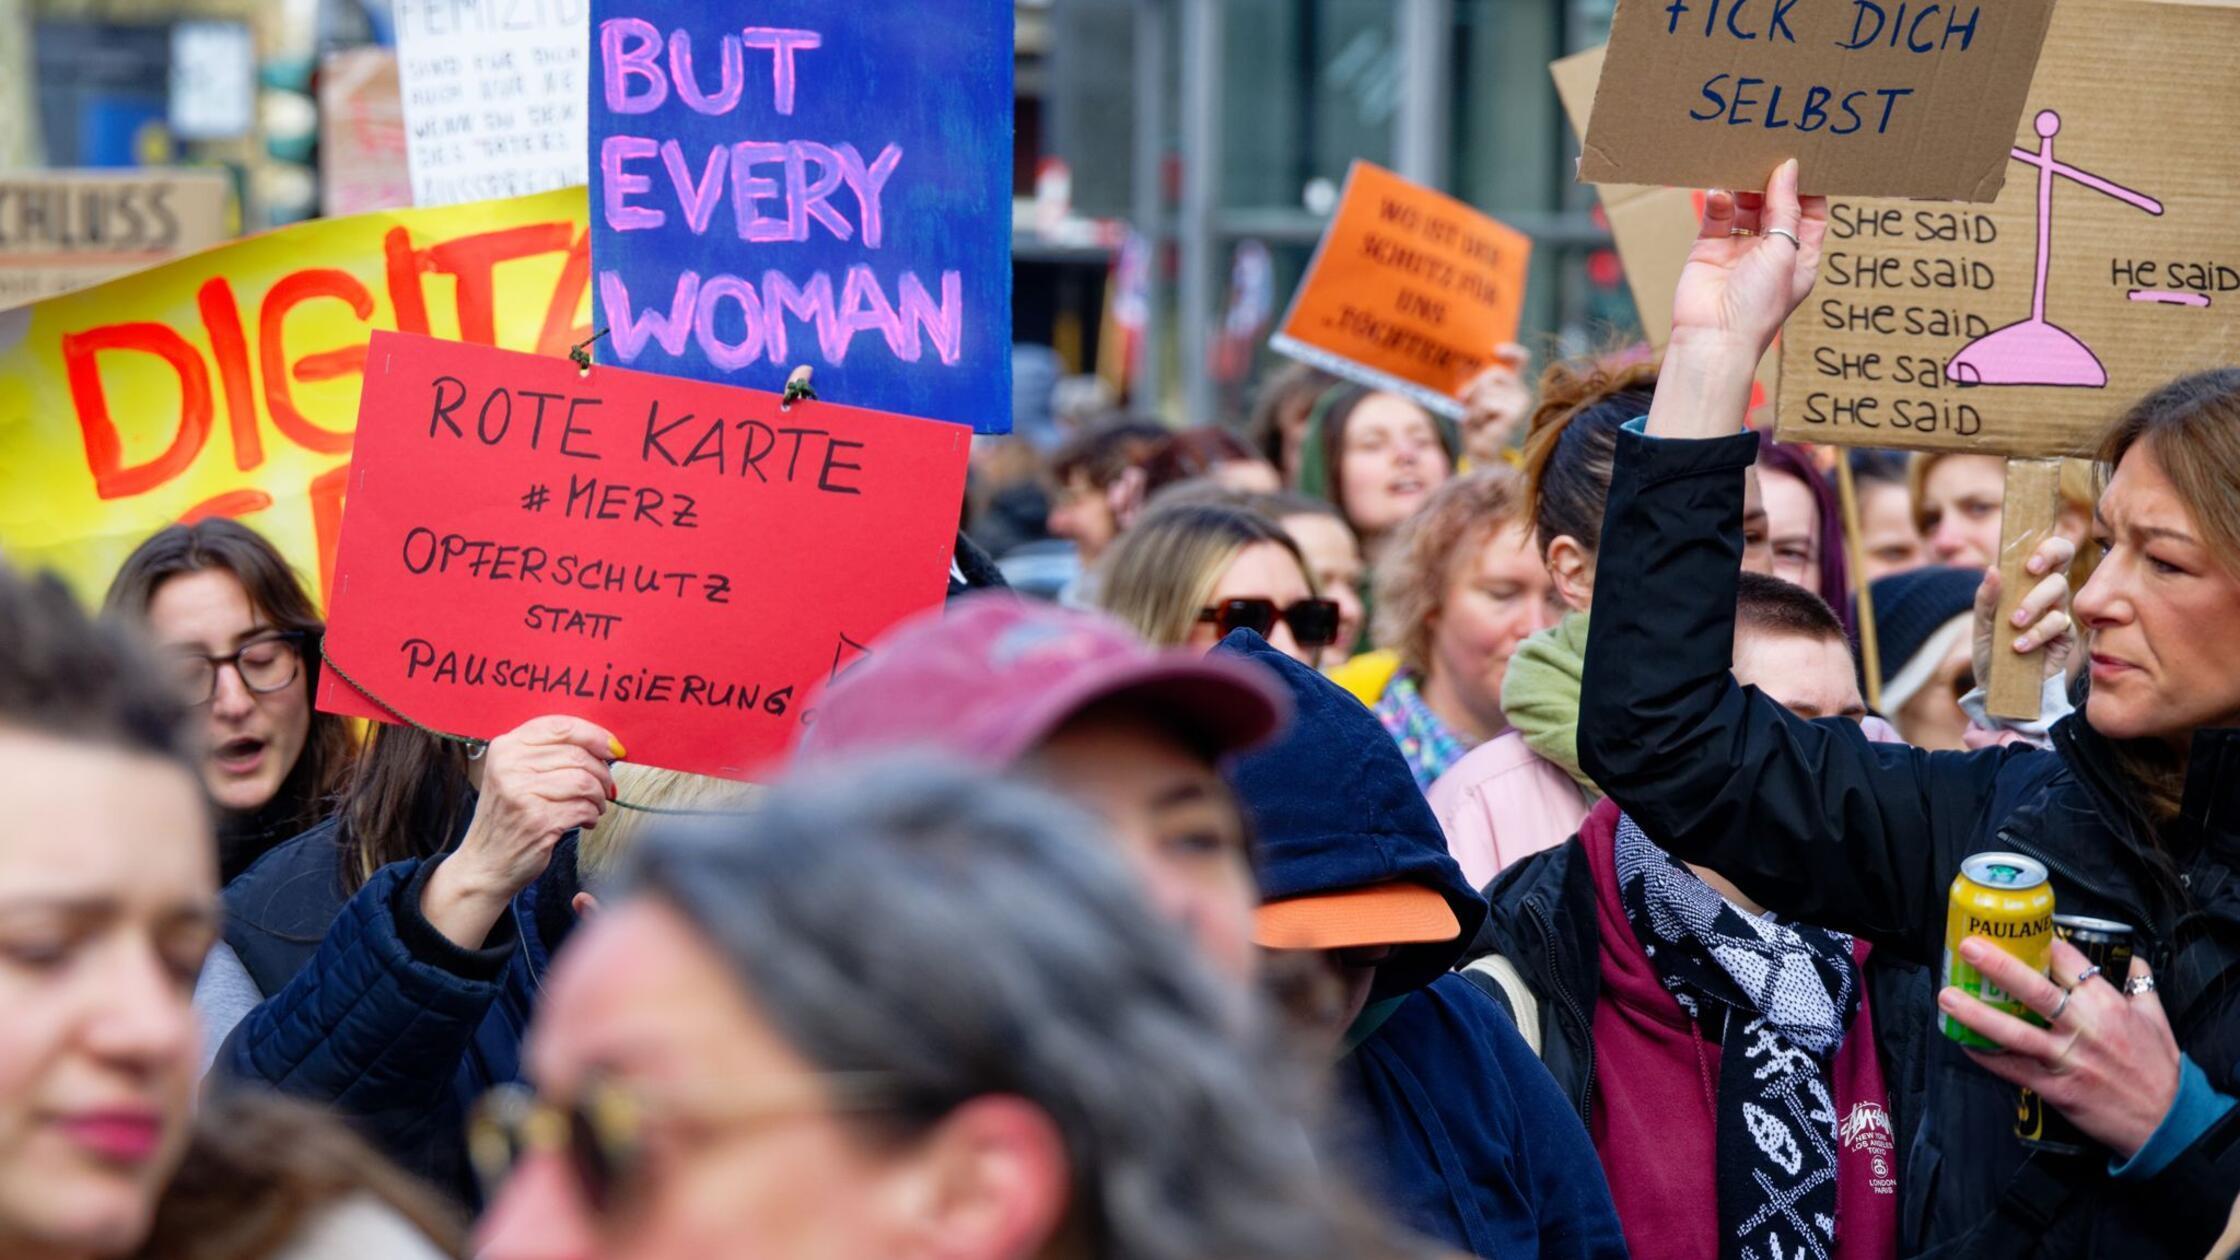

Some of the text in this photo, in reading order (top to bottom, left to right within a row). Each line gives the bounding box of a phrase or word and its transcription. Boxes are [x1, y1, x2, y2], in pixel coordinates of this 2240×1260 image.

[1834, 0, 1980, 52] DICH
[600, 17, 823, 116] BUT
[1690, 73, 1914, 134] SELBST
[601, 135, 902, 249] EVERY
[599, 262, 962, 372] WOMAN
[430, 376, 865, 494] ROTE KARTE
[403, 527, 732, 603] OPFERSCHUTZ
[524, 604, 622, 640] STATT
[1852, 1141, 1869, 1153] LOS
[1855, 1132, 1874, 1142] NEW
[1869, 1179, 1897, 1187] LONDON
[1874, 1186, 1893, 1194] PARIS
